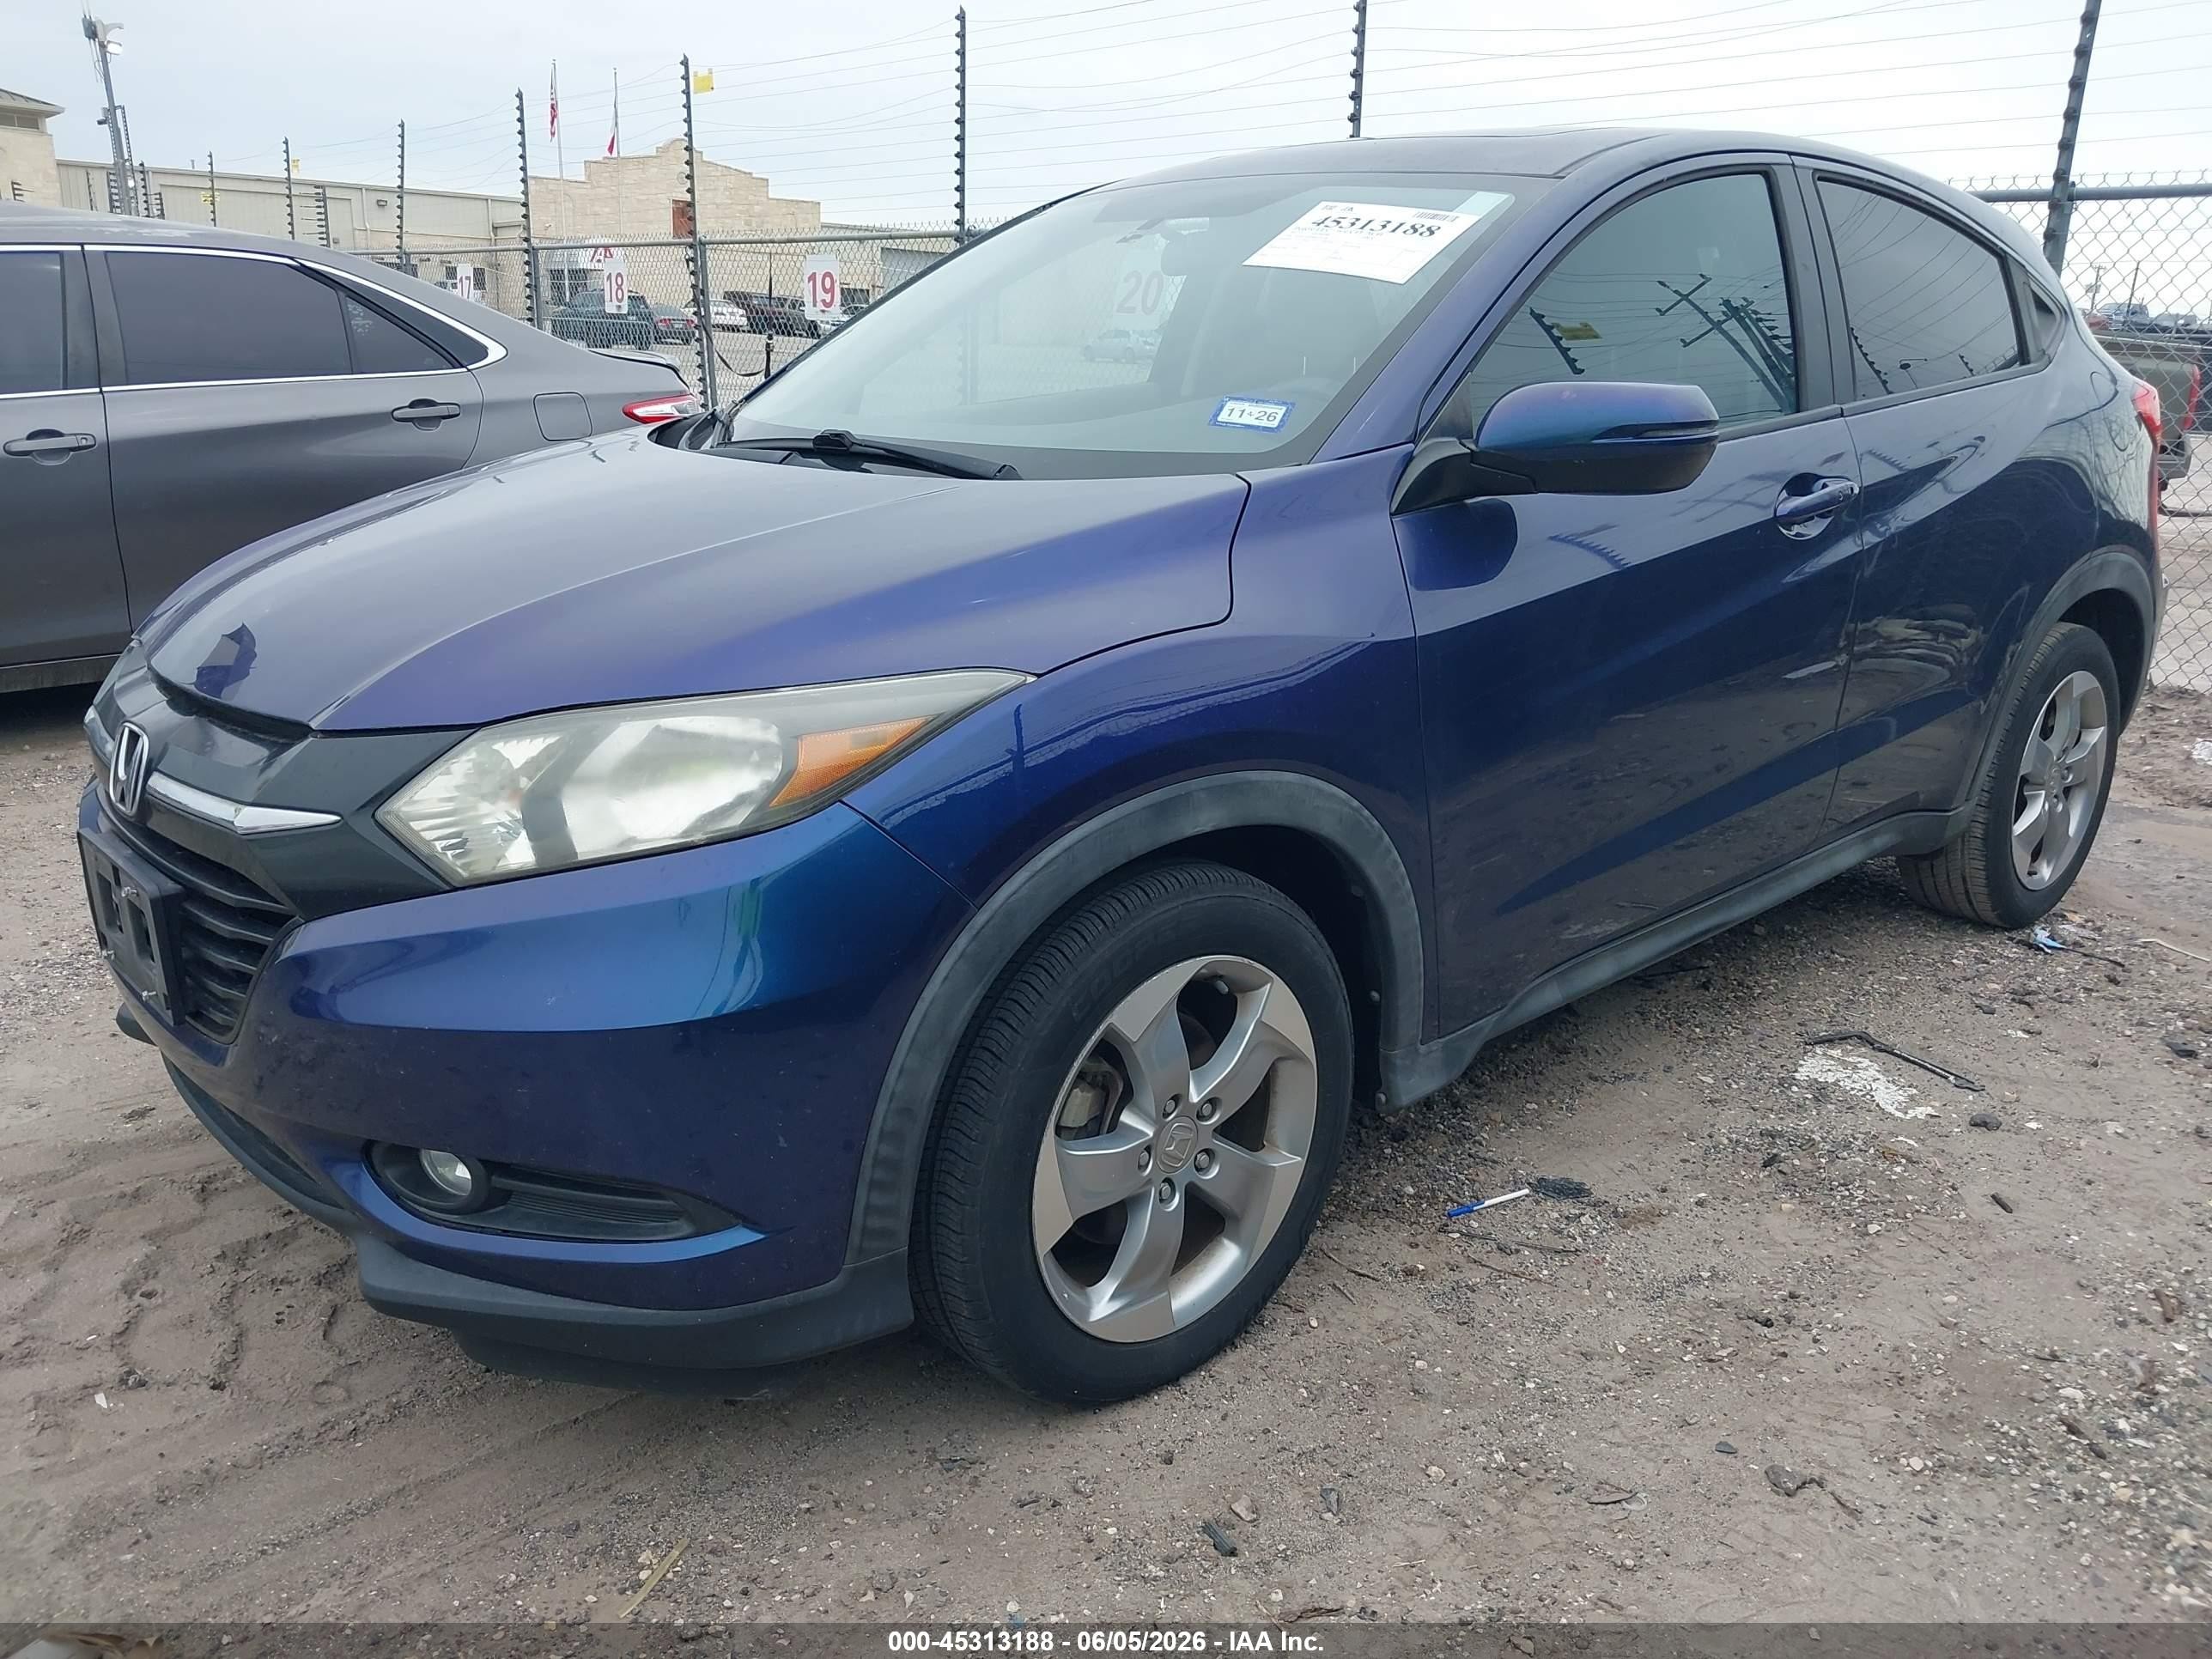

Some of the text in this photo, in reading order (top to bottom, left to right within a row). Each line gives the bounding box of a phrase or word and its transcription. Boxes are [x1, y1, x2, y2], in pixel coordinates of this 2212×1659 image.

[1312, 216, 1441, 238] 45313188
[606, 271, 625, 304] 18
[807, 271, 836, 308] 19
[1115, 270, 1164, 315] 20
